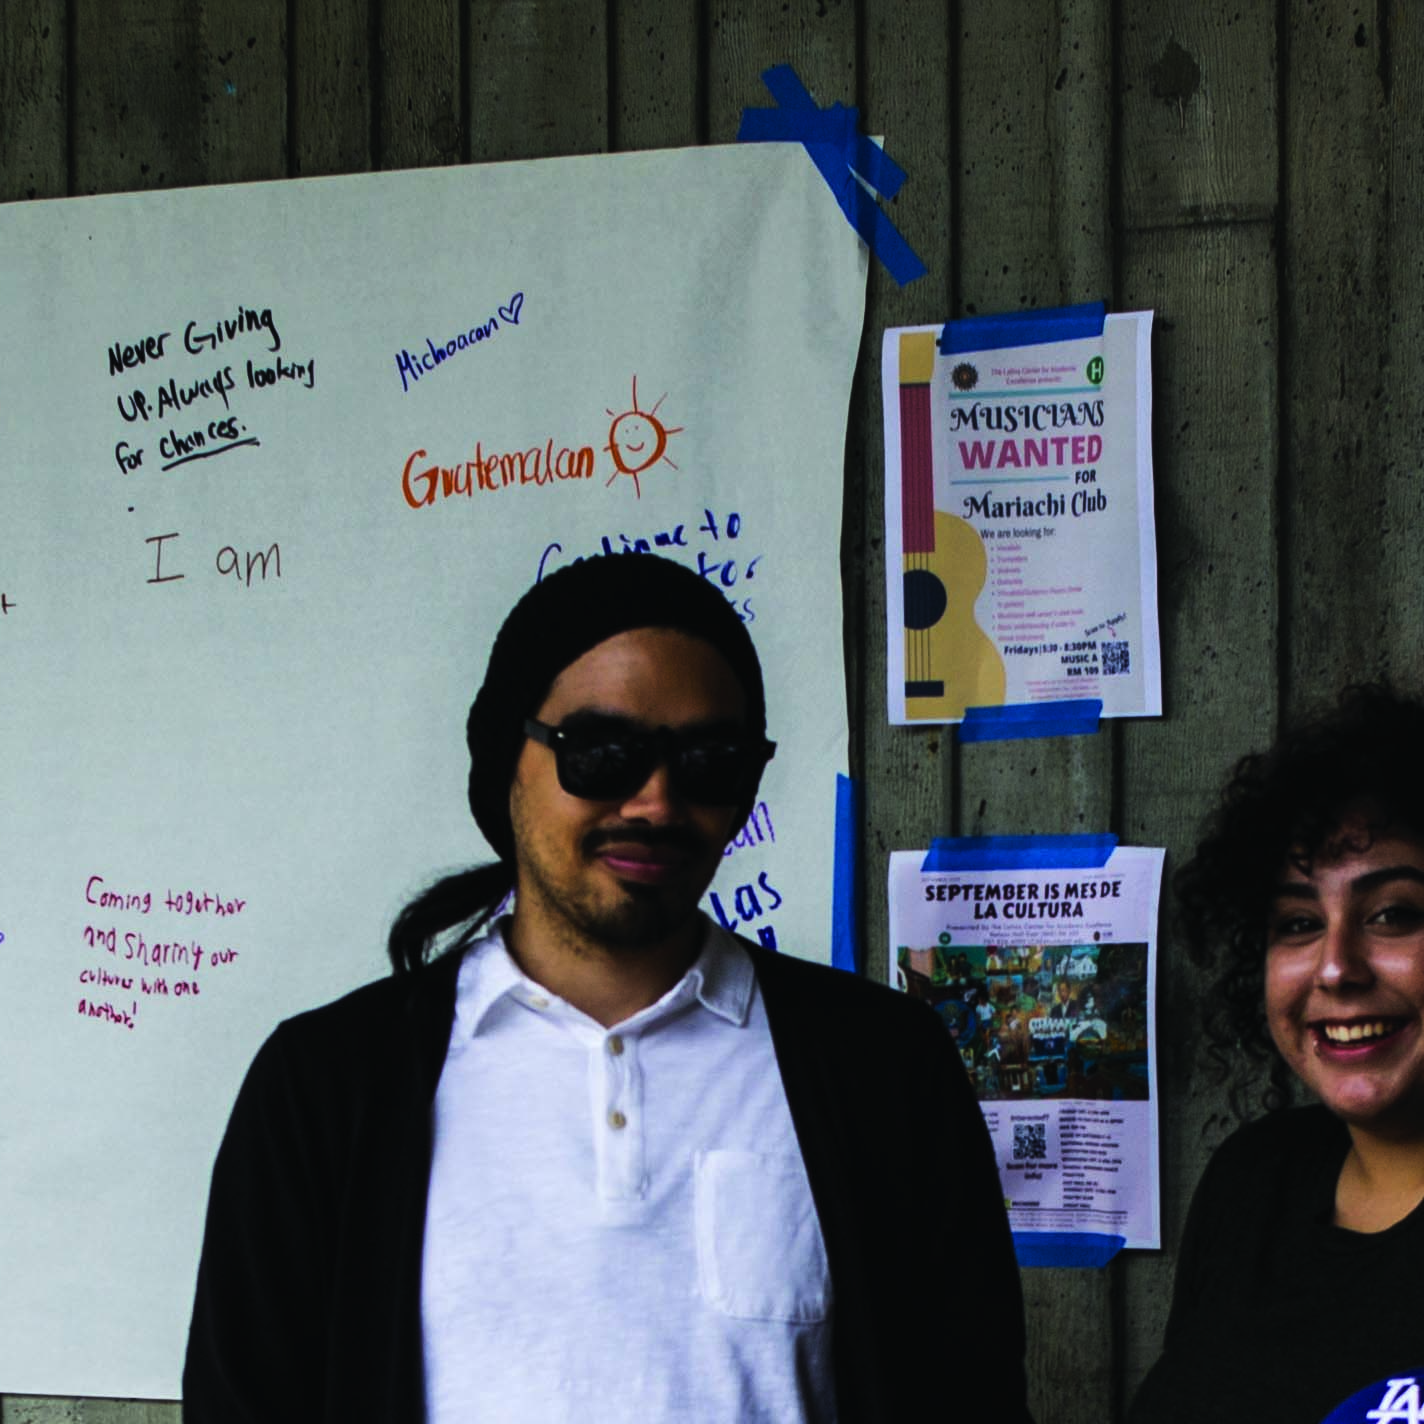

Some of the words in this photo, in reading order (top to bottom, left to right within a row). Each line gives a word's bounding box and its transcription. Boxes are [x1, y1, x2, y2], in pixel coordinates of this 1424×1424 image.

[109, 333, 171, 375] Never
[184, 306, 280, 352] Giving
[950, 400, 1104, 432] MUSICIANS
[958, 434, 1102, 470] WANTED
[1075, 470, 1096, 484] FOR
[962, 490, 1065, 519] Mariachi
[1071, 488, 1107, 517] Club
[980, 529, 995, 538] We
[997, 530, 1011, 538] are
[1013, 528, 1041, 539] looking
[145, 533, 184, 583] I
[216, 543, 280, 587] am
[1061, 654, 1089, 664] MUSIC
[1092, 654, 1098, 663] A
[1067, 667, 1082, 676] RM
[86, 876, 151, 914] Coming
[926, 883, 1039, 902] SEPTEMBER
[1044, 882, 1060, 900] IS
[1064, 881, 1096, 899] MES
[1100, 880, 1122, 898] DE
[974, 903, 997, 920] LA
[1003, 902, 1084, 919] CULTURA
[211, 948, 238, 967] our
[141, 977, 168, 994] with
[174, 980, 200, 996] one
